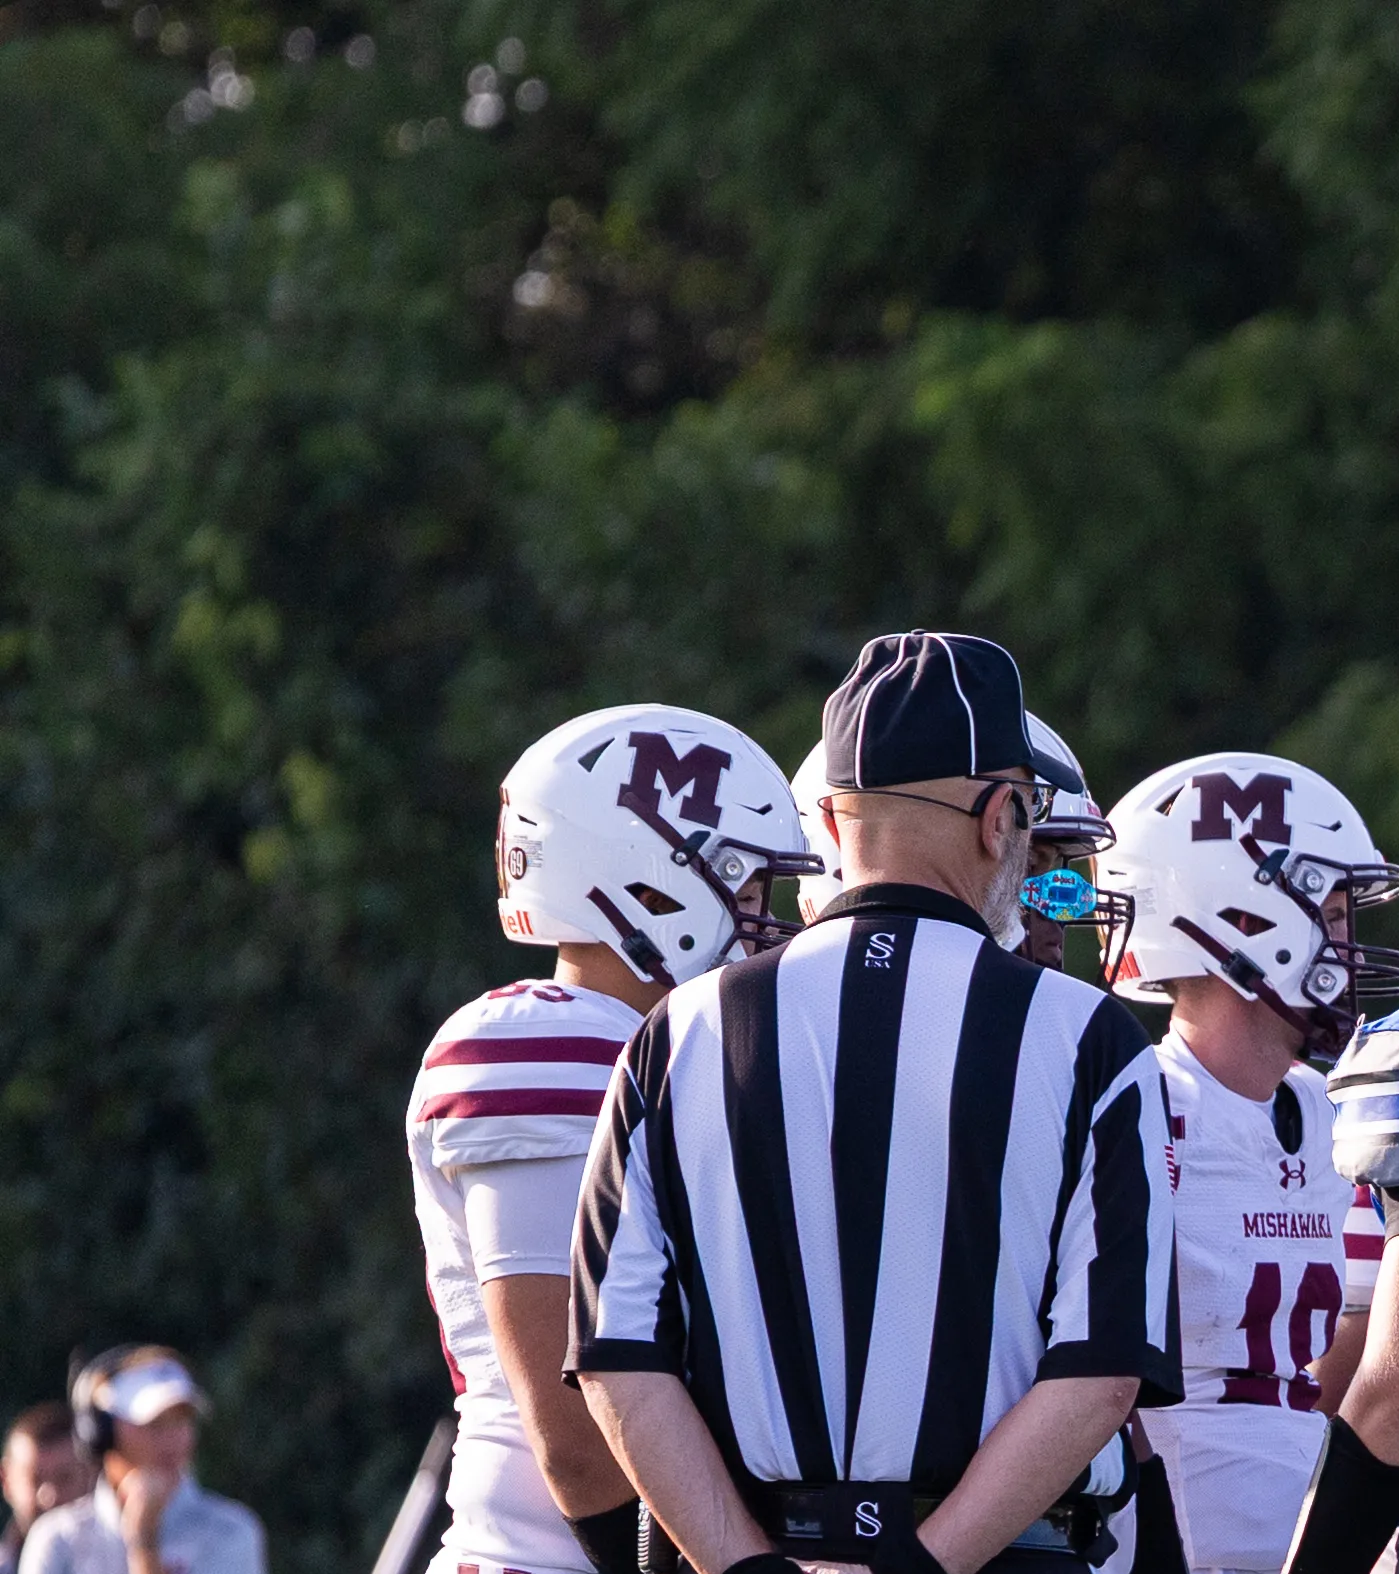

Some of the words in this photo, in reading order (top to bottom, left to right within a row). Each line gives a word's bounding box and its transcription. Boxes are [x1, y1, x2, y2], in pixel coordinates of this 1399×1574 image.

[617, 731, 731, 829] M
[1192, 772, 1292, 845] M
[511, 850, 523, 876] 69
[864, 960, 890, 969] USA
[1242, 1212, 1333, 1239] MISHAWAKA
[1218, 1262, 1343, 1412] 10
[855, 1501, 882, 1537] S
